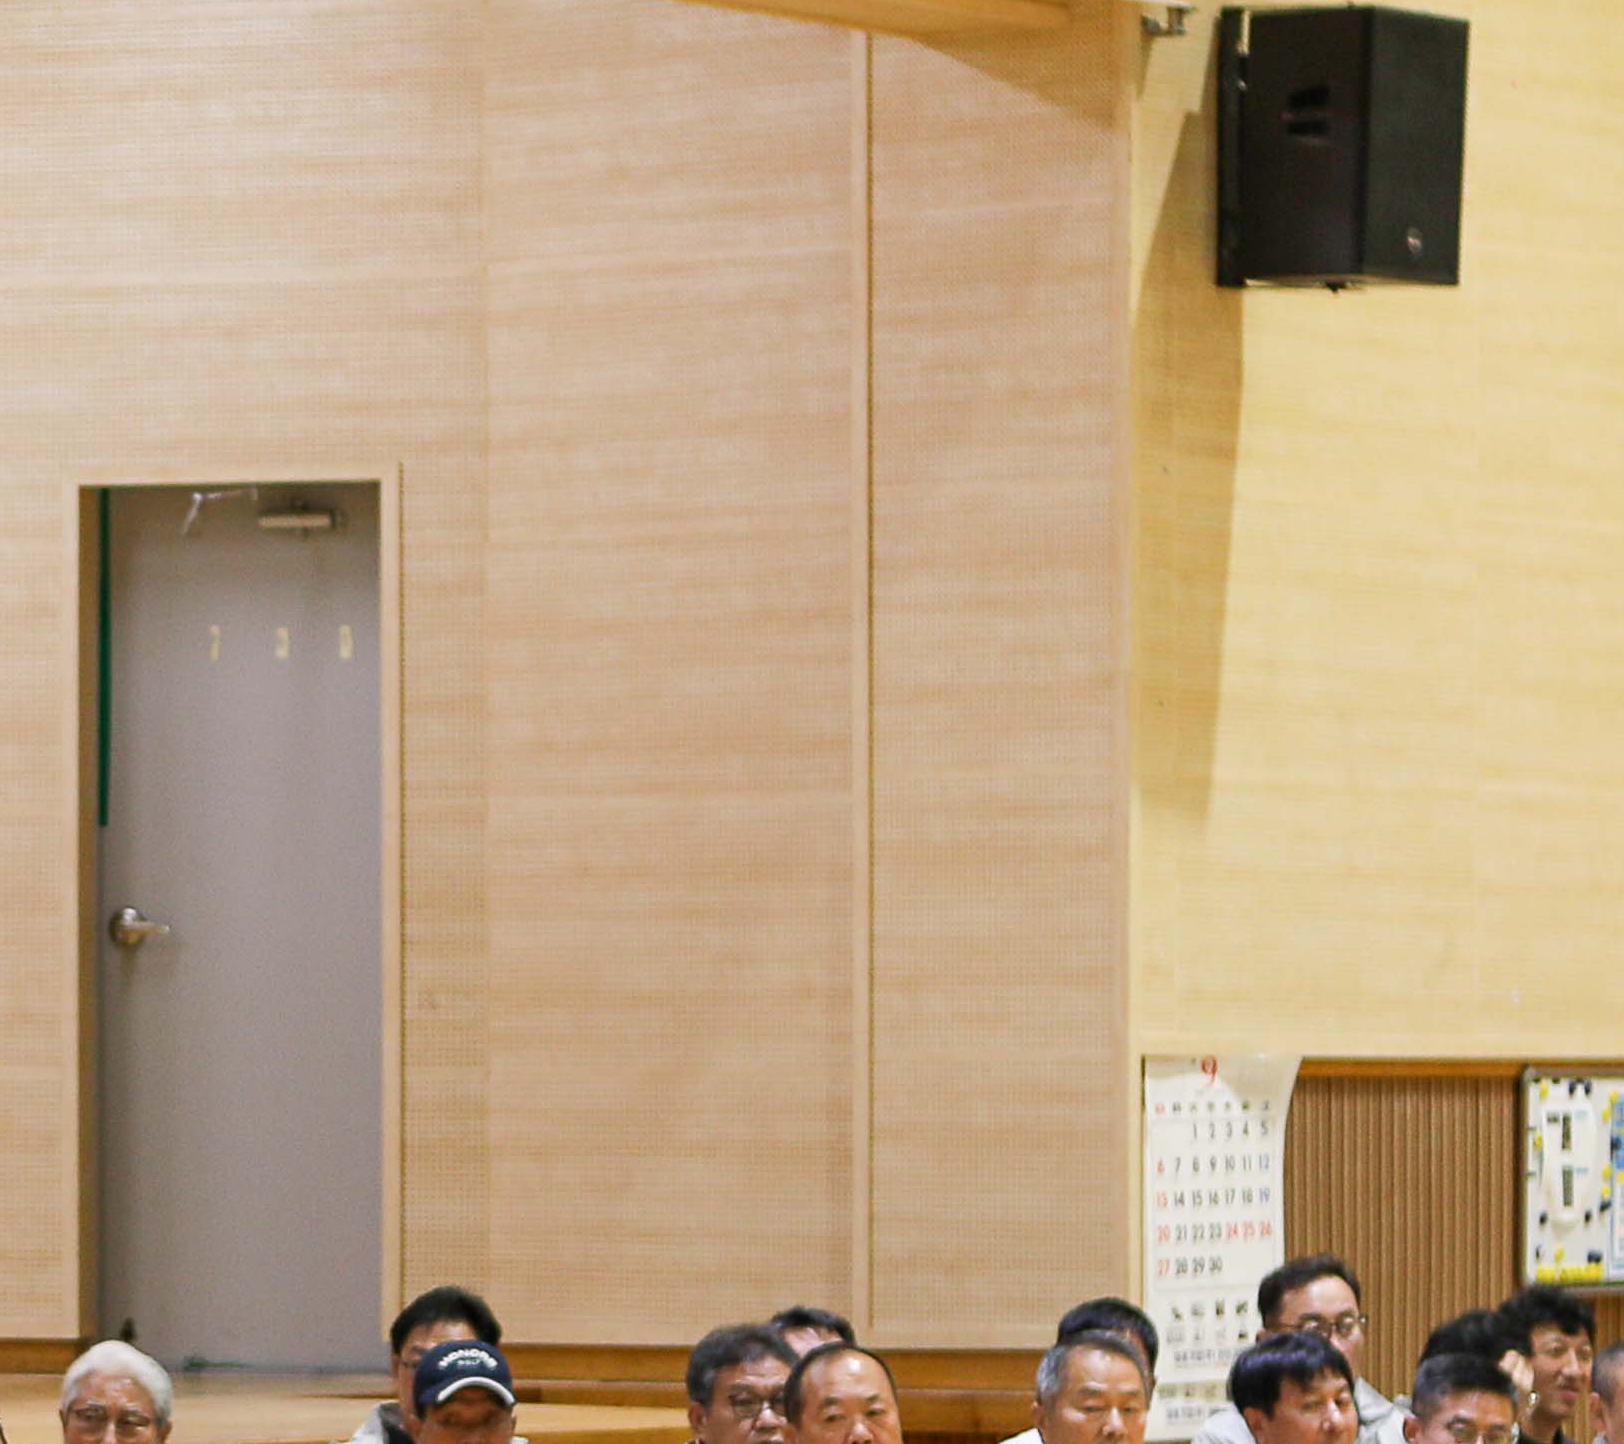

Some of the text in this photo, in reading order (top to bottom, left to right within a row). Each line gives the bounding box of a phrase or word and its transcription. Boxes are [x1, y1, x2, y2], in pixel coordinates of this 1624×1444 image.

[1201, 1056, 1218, 1086] 9
[1192, 1121, 1268, 1139] 1 2 3 4 5
[1157, 1155, 1270, 1175] 6 7 8 9 10 11 12
[1158, 1188, 1270, 1207] 13 14 15 16 17 18 19
[1158, 1222, 1273, 1243] 20 21 22 23 24 25 26
[1158, 1260, 1222, 1275] 27 28 29 30
